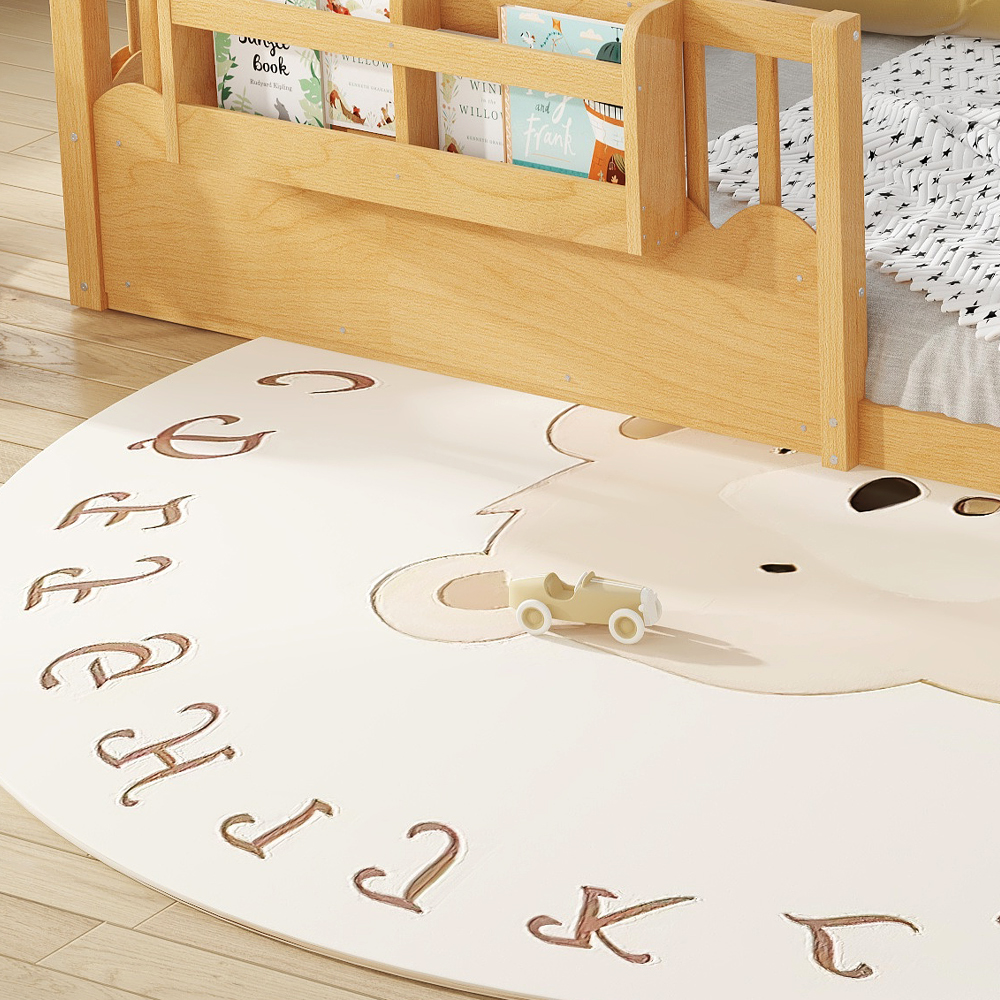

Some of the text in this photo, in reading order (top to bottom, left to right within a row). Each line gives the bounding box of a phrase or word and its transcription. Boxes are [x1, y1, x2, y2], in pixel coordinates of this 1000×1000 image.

[250, 78, 293, 93] Rudyard Kipling
[459, 104, 503, 121] WILLO
[535, 101, 551, 114] and
[523, 112, 577, 158] Frank
